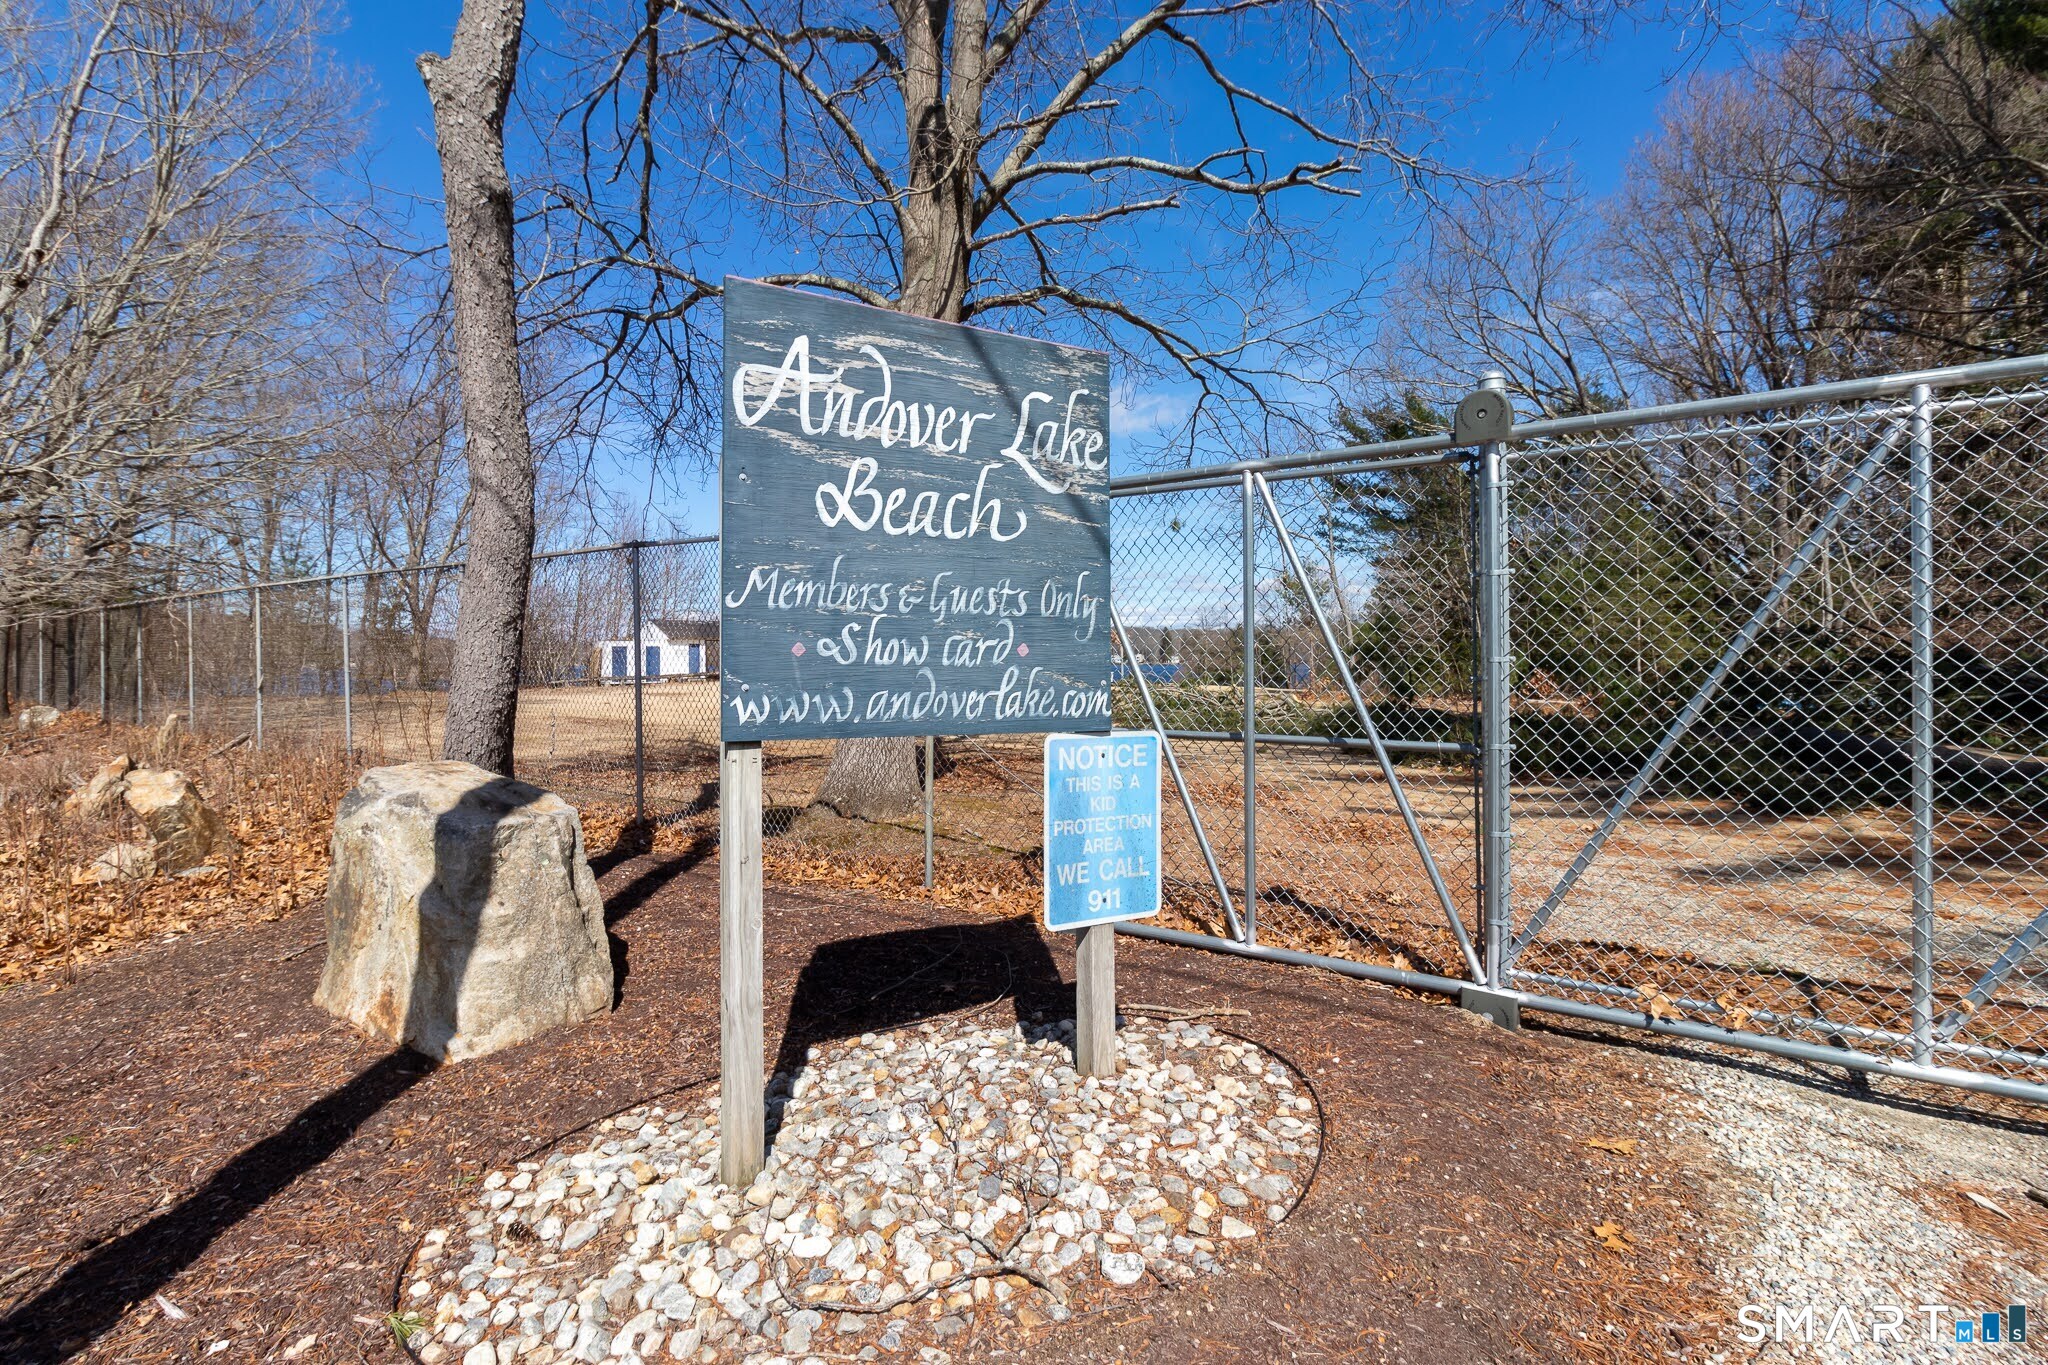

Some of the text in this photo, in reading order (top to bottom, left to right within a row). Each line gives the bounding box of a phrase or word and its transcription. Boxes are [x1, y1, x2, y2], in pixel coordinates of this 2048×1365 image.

[732, 334, 1108, 494] Andover Lake
[815, 456, 1028, 542] Beach
[725, 554, 1104, 642] Members & Guests Only
[816, 613, 929, 665] Show
[730, 664, 1112, 726] www.andoverlake.com
[1058, 743, 1148, 771] NOTICE
[1066, 774, 1140, 792] THIS IS A
[1091, 796, 1116, 812] KID
[1053, 813, 1152, 837] PROTECTION
[1083, 837, 1125, 855] AREA
[1057, 856, 1150, 886] WE CALL
[1088, 888, 1121, 912] 911
